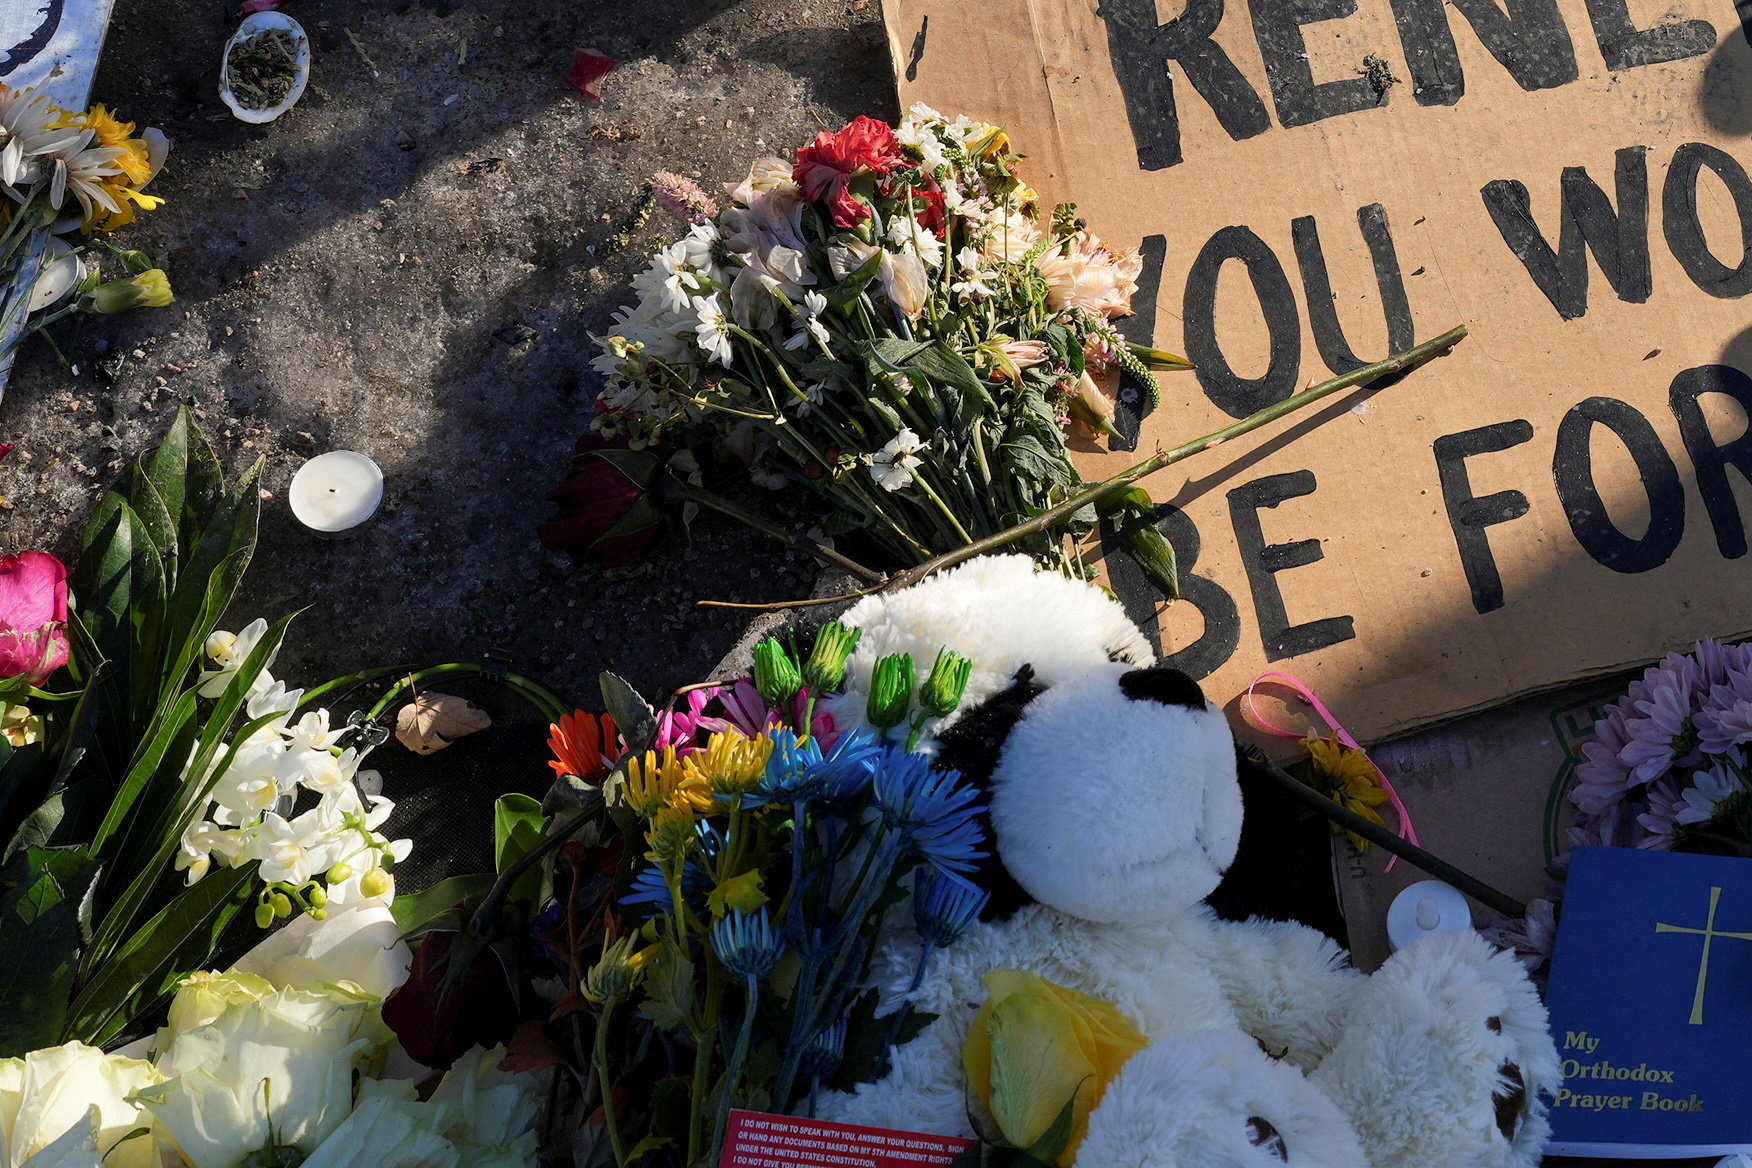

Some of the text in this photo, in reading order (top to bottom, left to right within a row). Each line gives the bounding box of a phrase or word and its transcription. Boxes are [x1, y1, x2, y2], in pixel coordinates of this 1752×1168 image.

[1096, 469, 1358, 680] BE
[1563, 1030, 1601, 1055] My
[1559, 1058, 1675, 1083] Orthodox
[1553, 1087, 1705, 1113] Prayer Book
